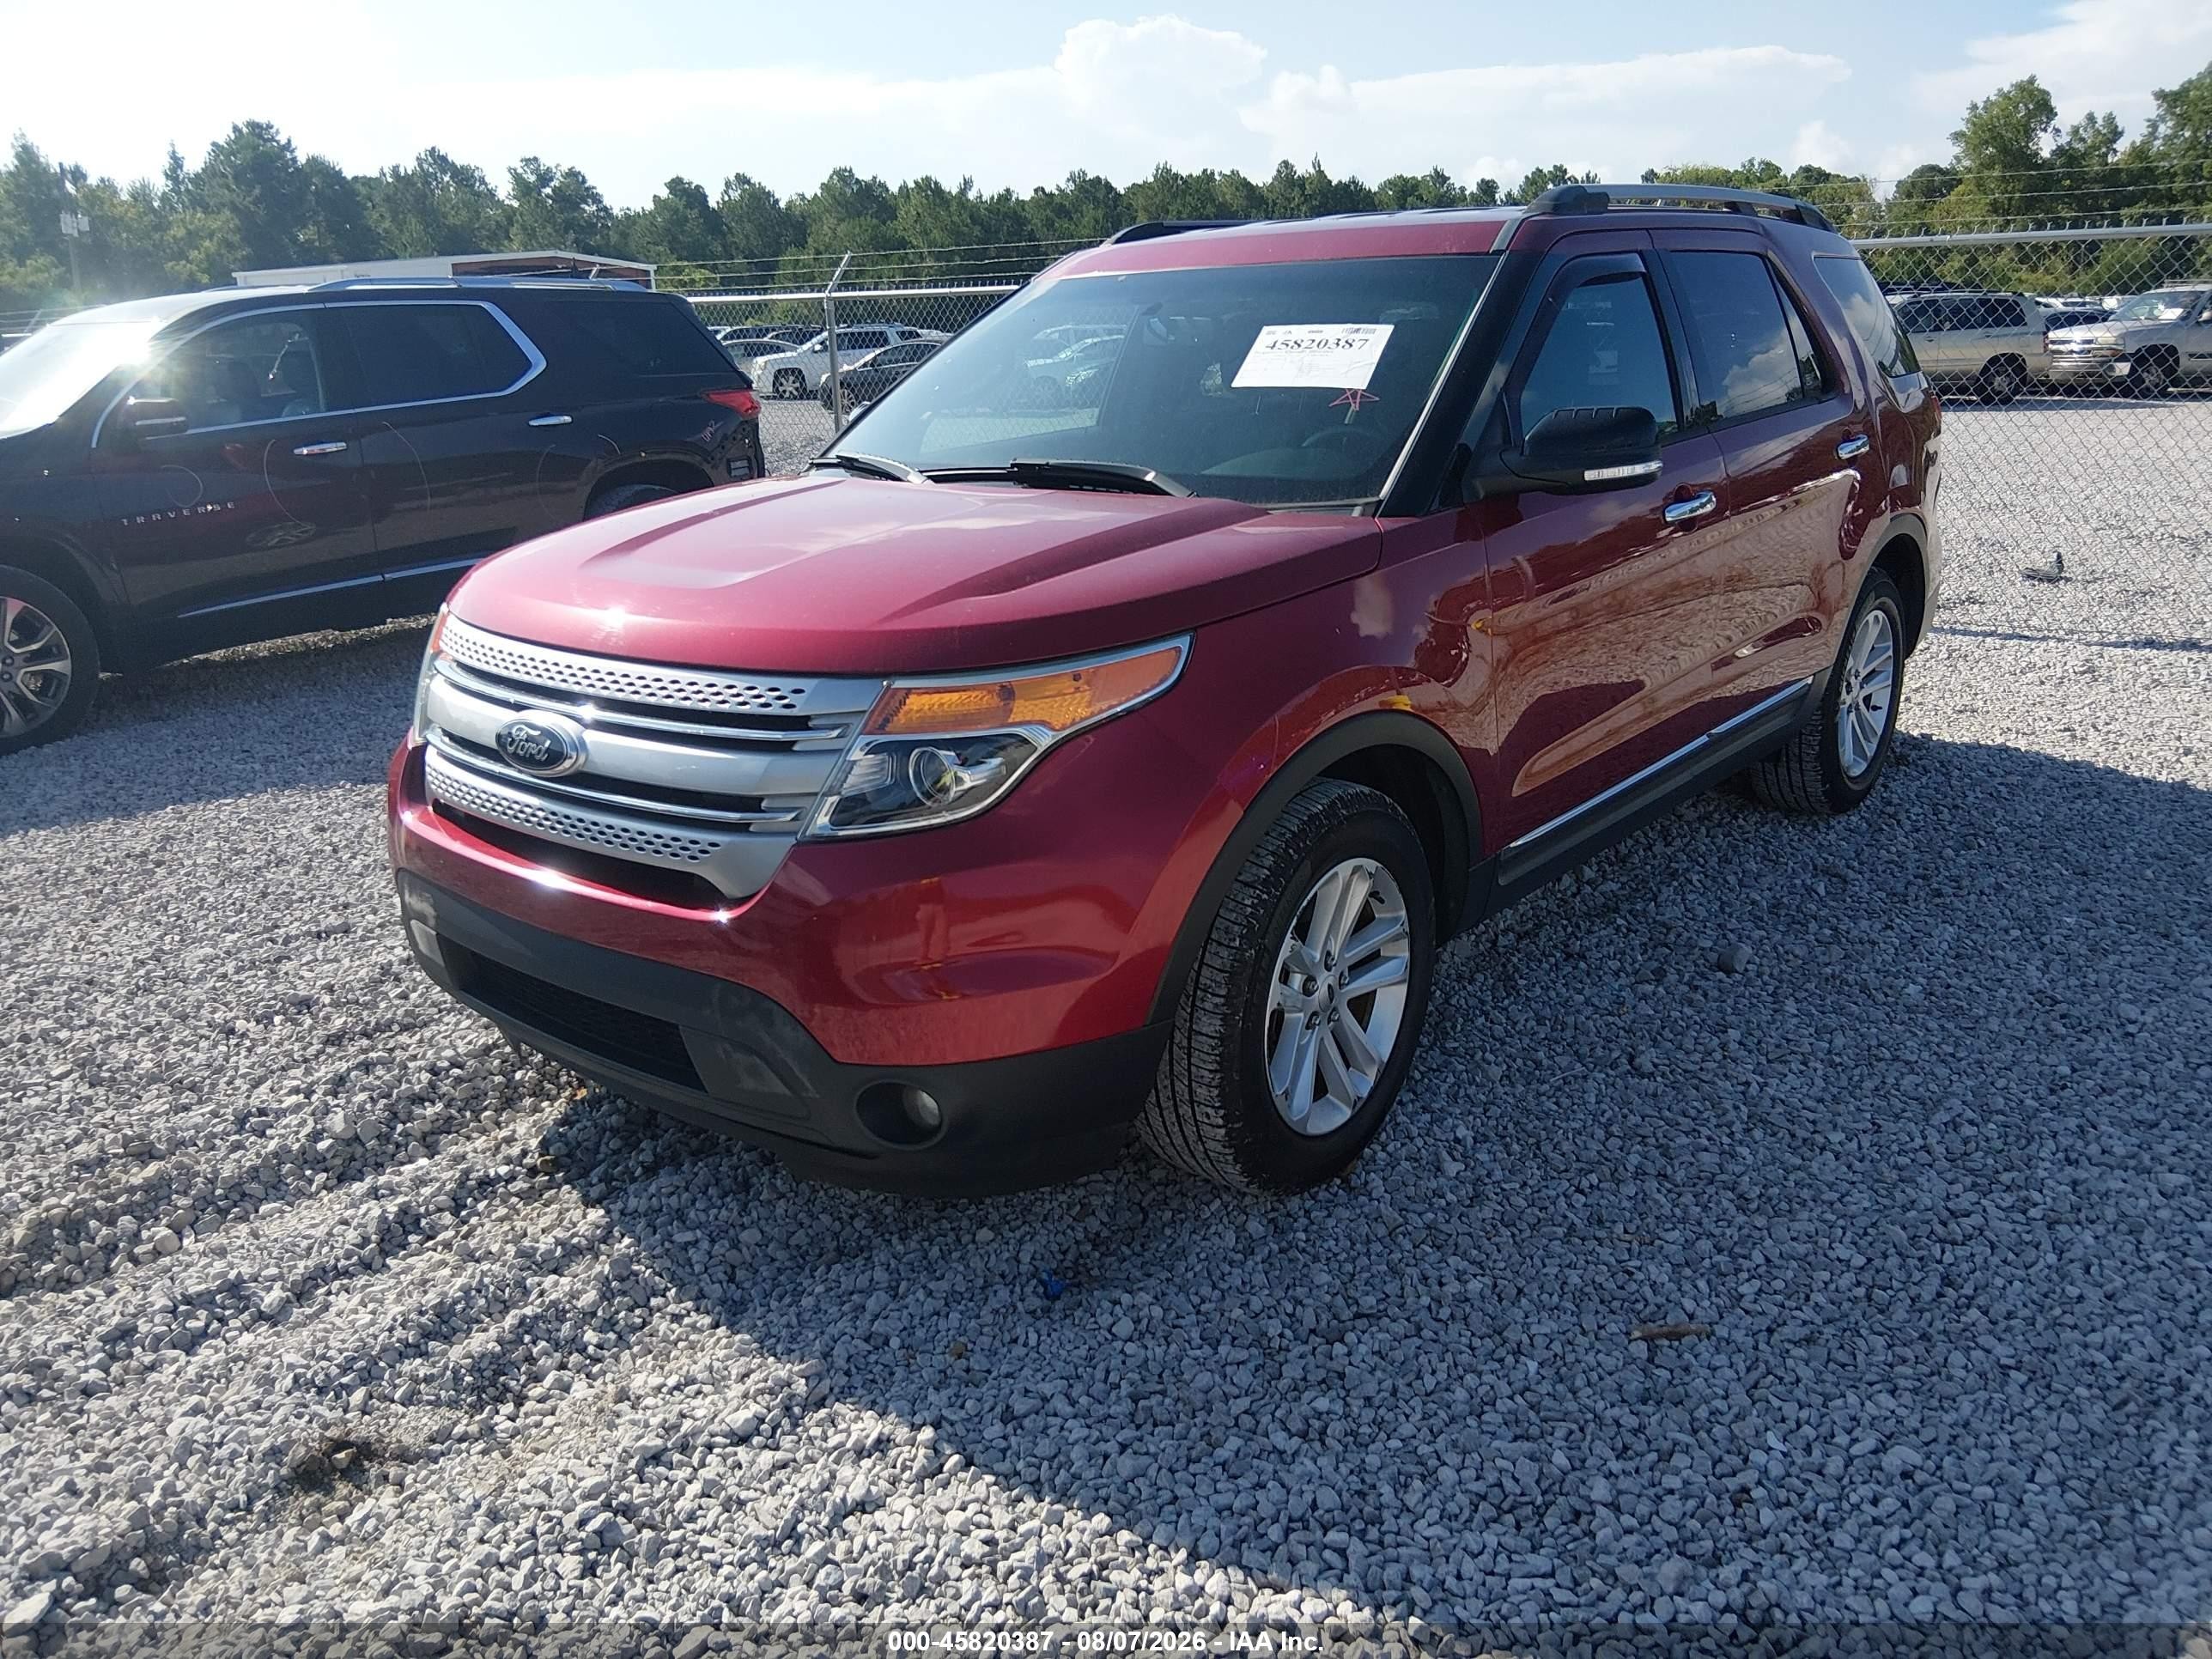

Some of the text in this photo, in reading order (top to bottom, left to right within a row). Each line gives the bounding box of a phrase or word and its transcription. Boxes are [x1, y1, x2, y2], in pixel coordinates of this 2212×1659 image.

[1265, 337, 1370, 350] 45820387
[121, 501, 235, 526] TRAVERSE
[507, 724, 551, 762] Ford
